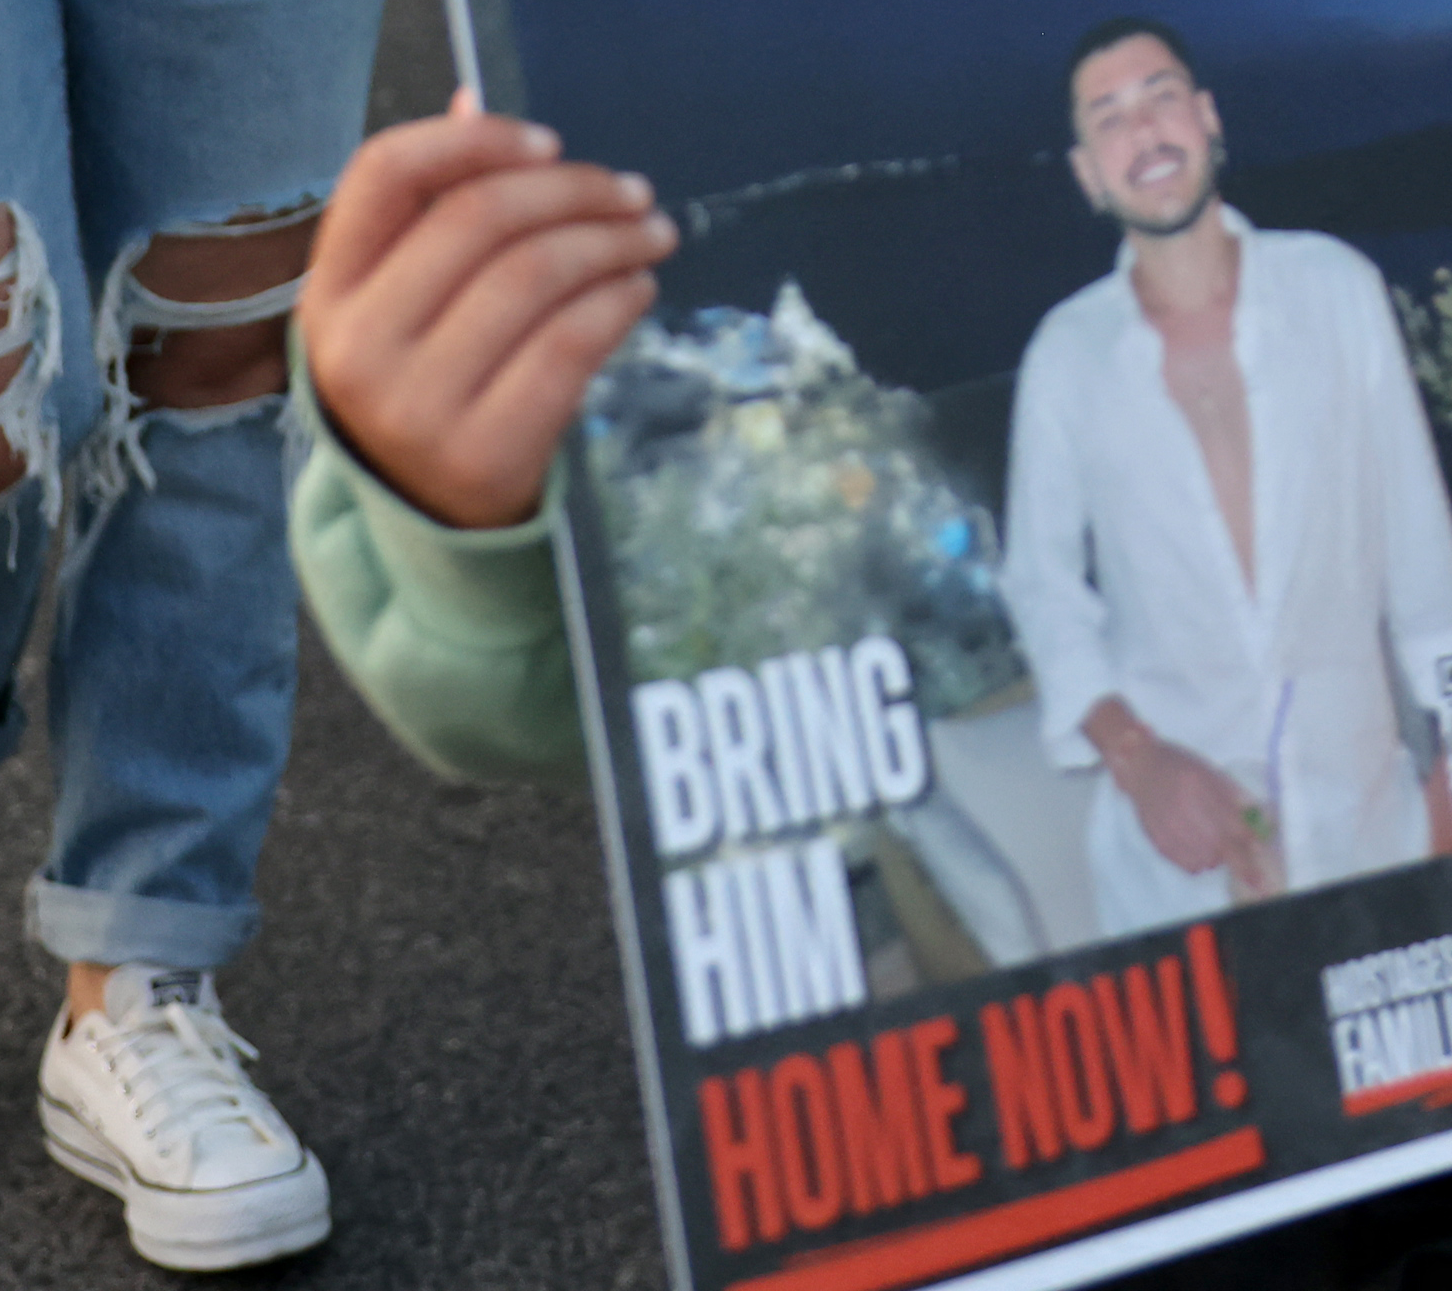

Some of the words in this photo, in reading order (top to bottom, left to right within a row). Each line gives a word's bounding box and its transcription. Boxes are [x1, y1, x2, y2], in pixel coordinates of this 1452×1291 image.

[631, 634, 930, 857] BRING
[665, 834, 868, 1049] HIM
[698, 1014, 983, 1252] HOME
[979, 922, 1247, 1170] NOW!
